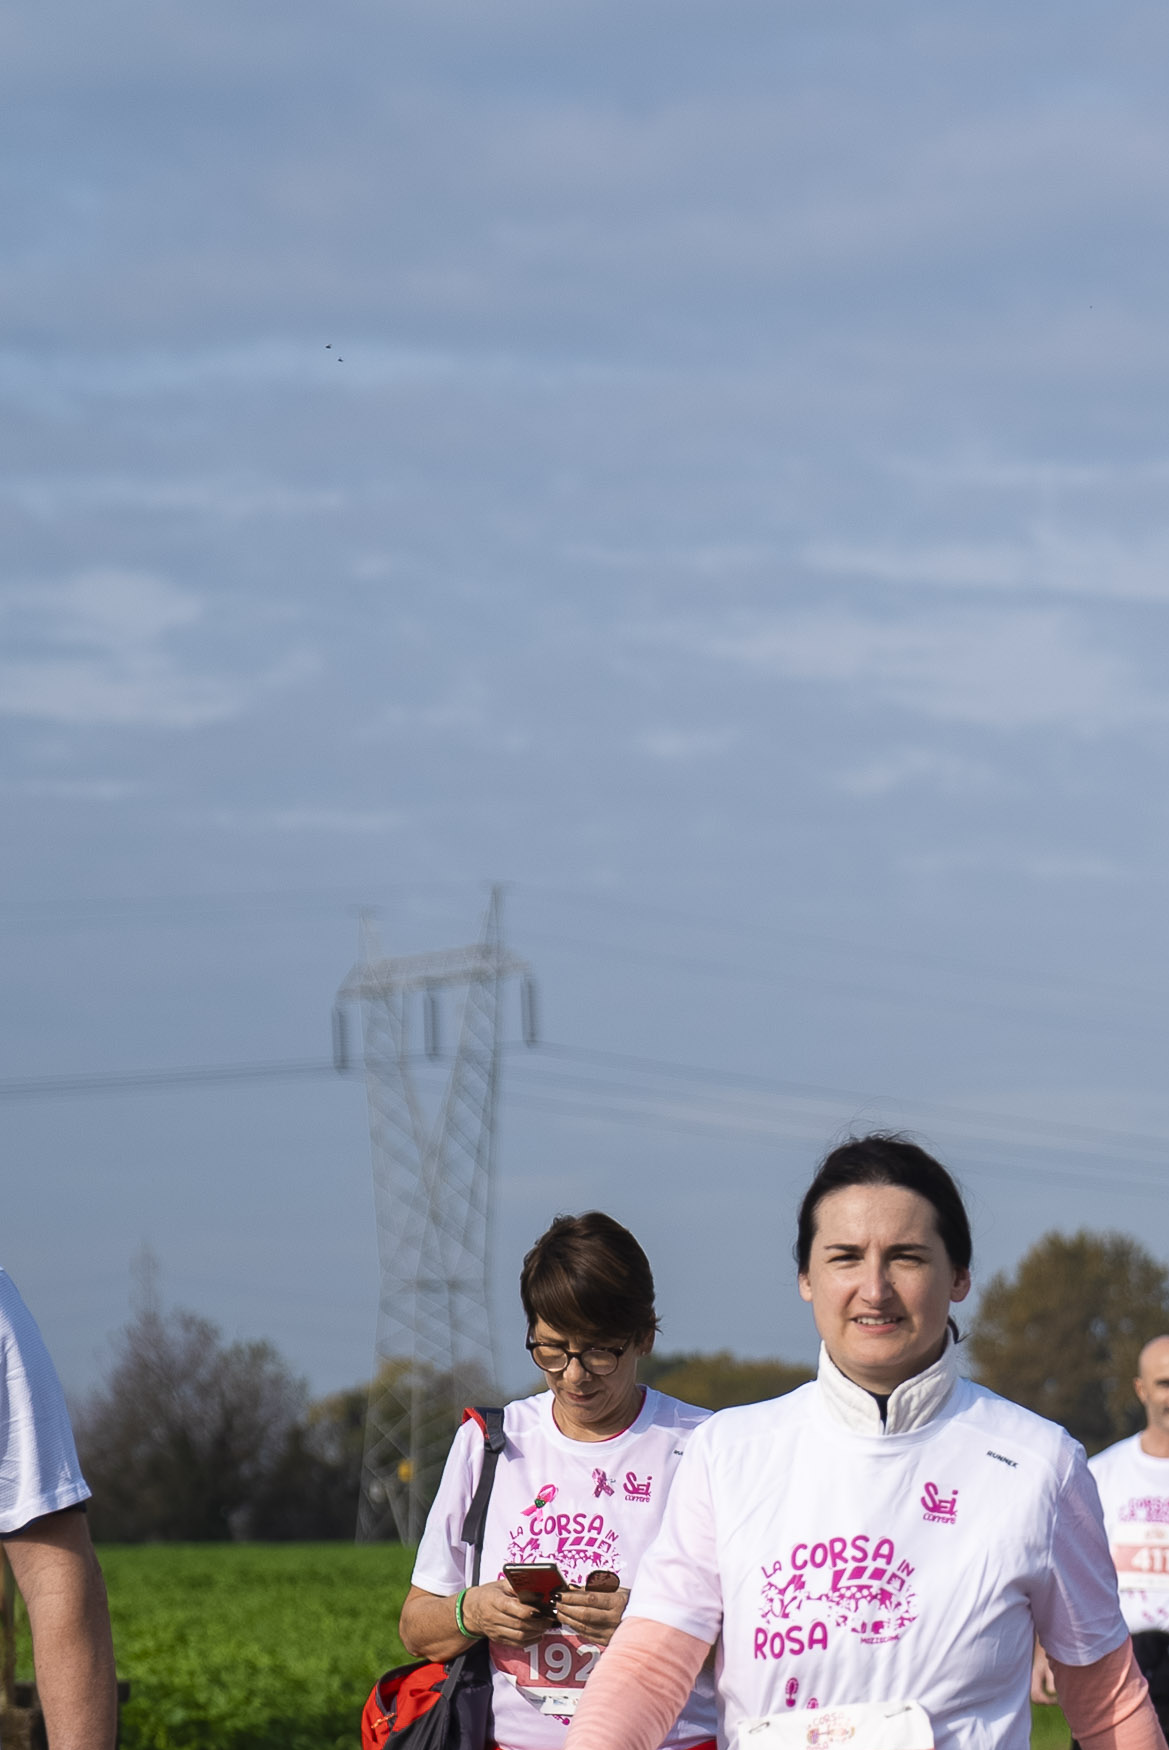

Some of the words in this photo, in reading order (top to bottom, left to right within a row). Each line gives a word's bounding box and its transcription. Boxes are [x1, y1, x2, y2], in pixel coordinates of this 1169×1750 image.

[509, 1526, 524, 1540] LA
[529, 1512, 604, 1537] CORSA
[605, 1529, 620, 1543] IN
[761, 1560, 783, 1579] LA
[791, 1535, 895, 1571] CORSA
[897, 1559, 916, 1577] IN
[754, 1621, 829, 1661] ROSA
[523, 1643, 602, 1682] 192
